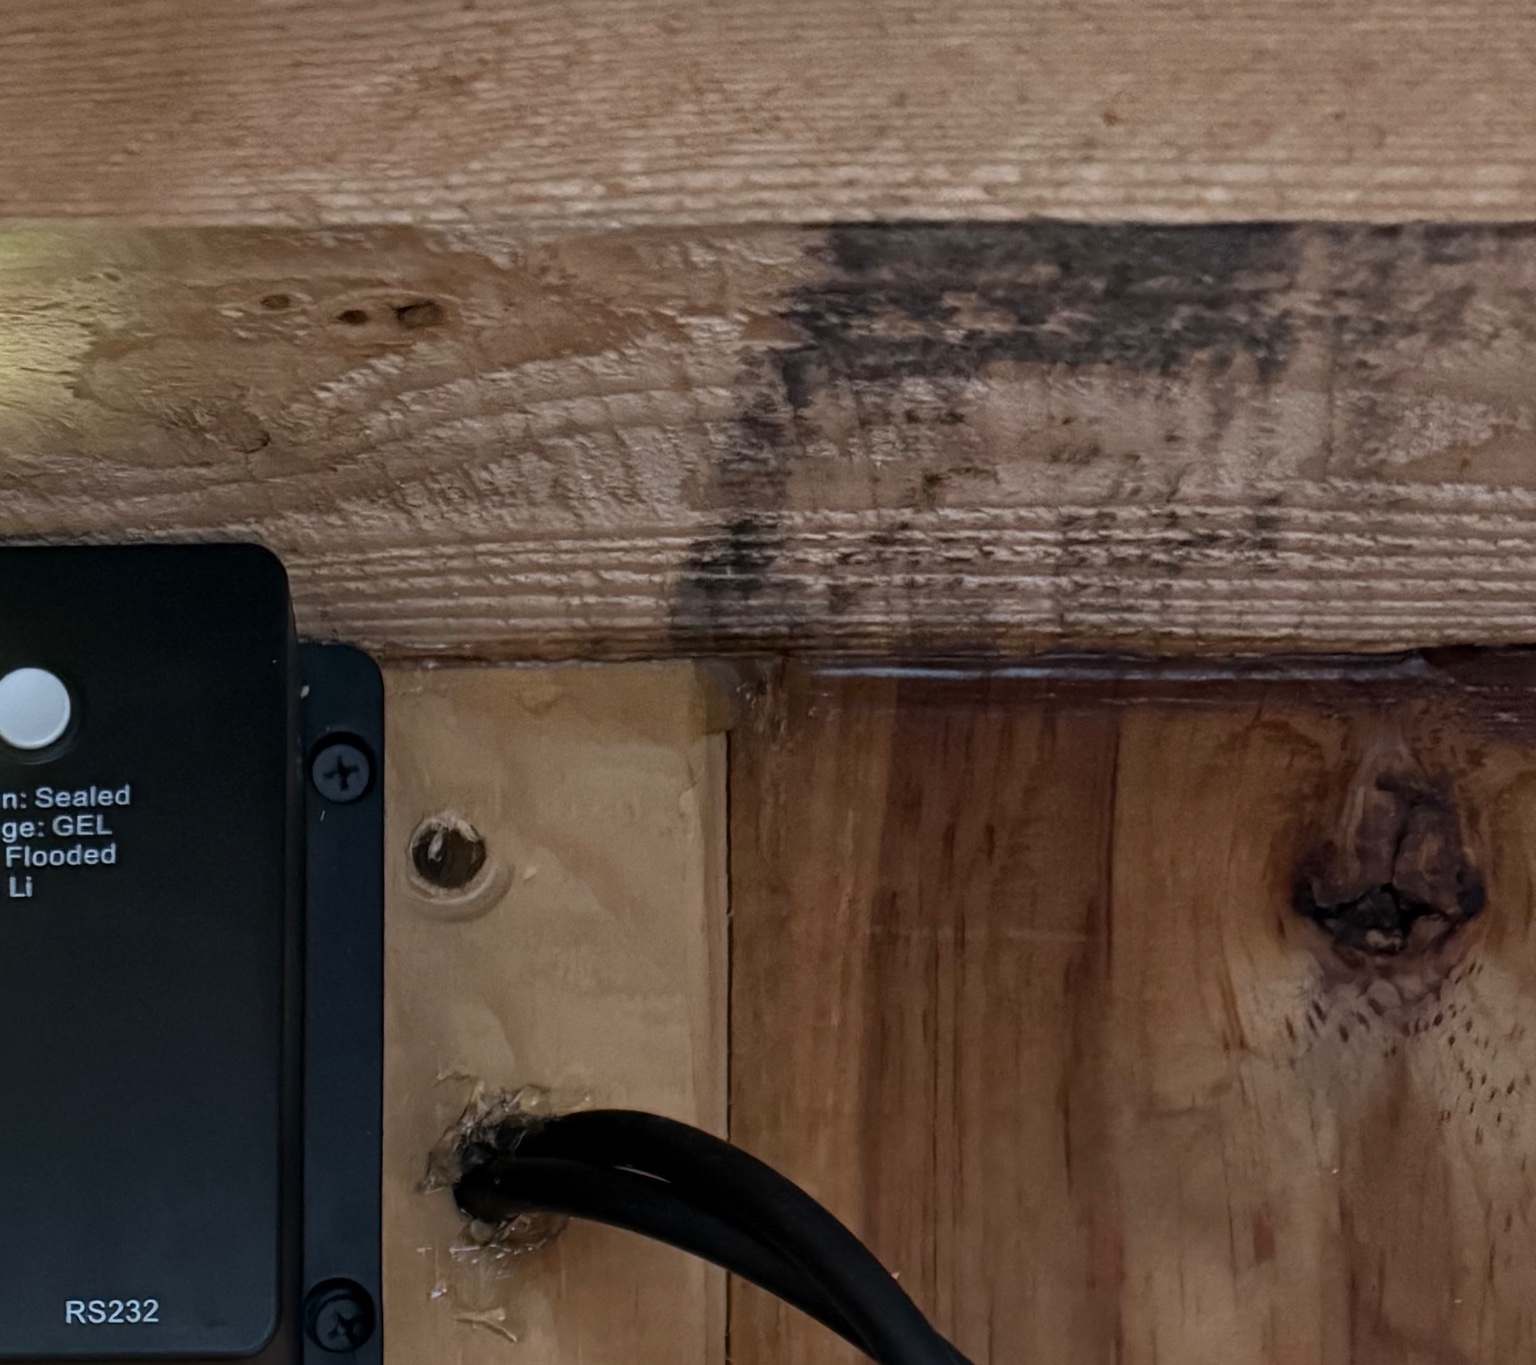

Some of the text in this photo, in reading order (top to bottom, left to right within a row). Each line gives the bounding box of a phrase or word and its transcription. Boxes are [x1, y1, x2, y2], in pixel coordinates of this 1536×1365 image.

[35, 784, 132, 809] Sealed
[52, 815, 114, 838] GEL
[6, 842, 118, 869] Flooded
[9, 876, 35, 900] Li
[65, 1298, 162, 1327] RS232
